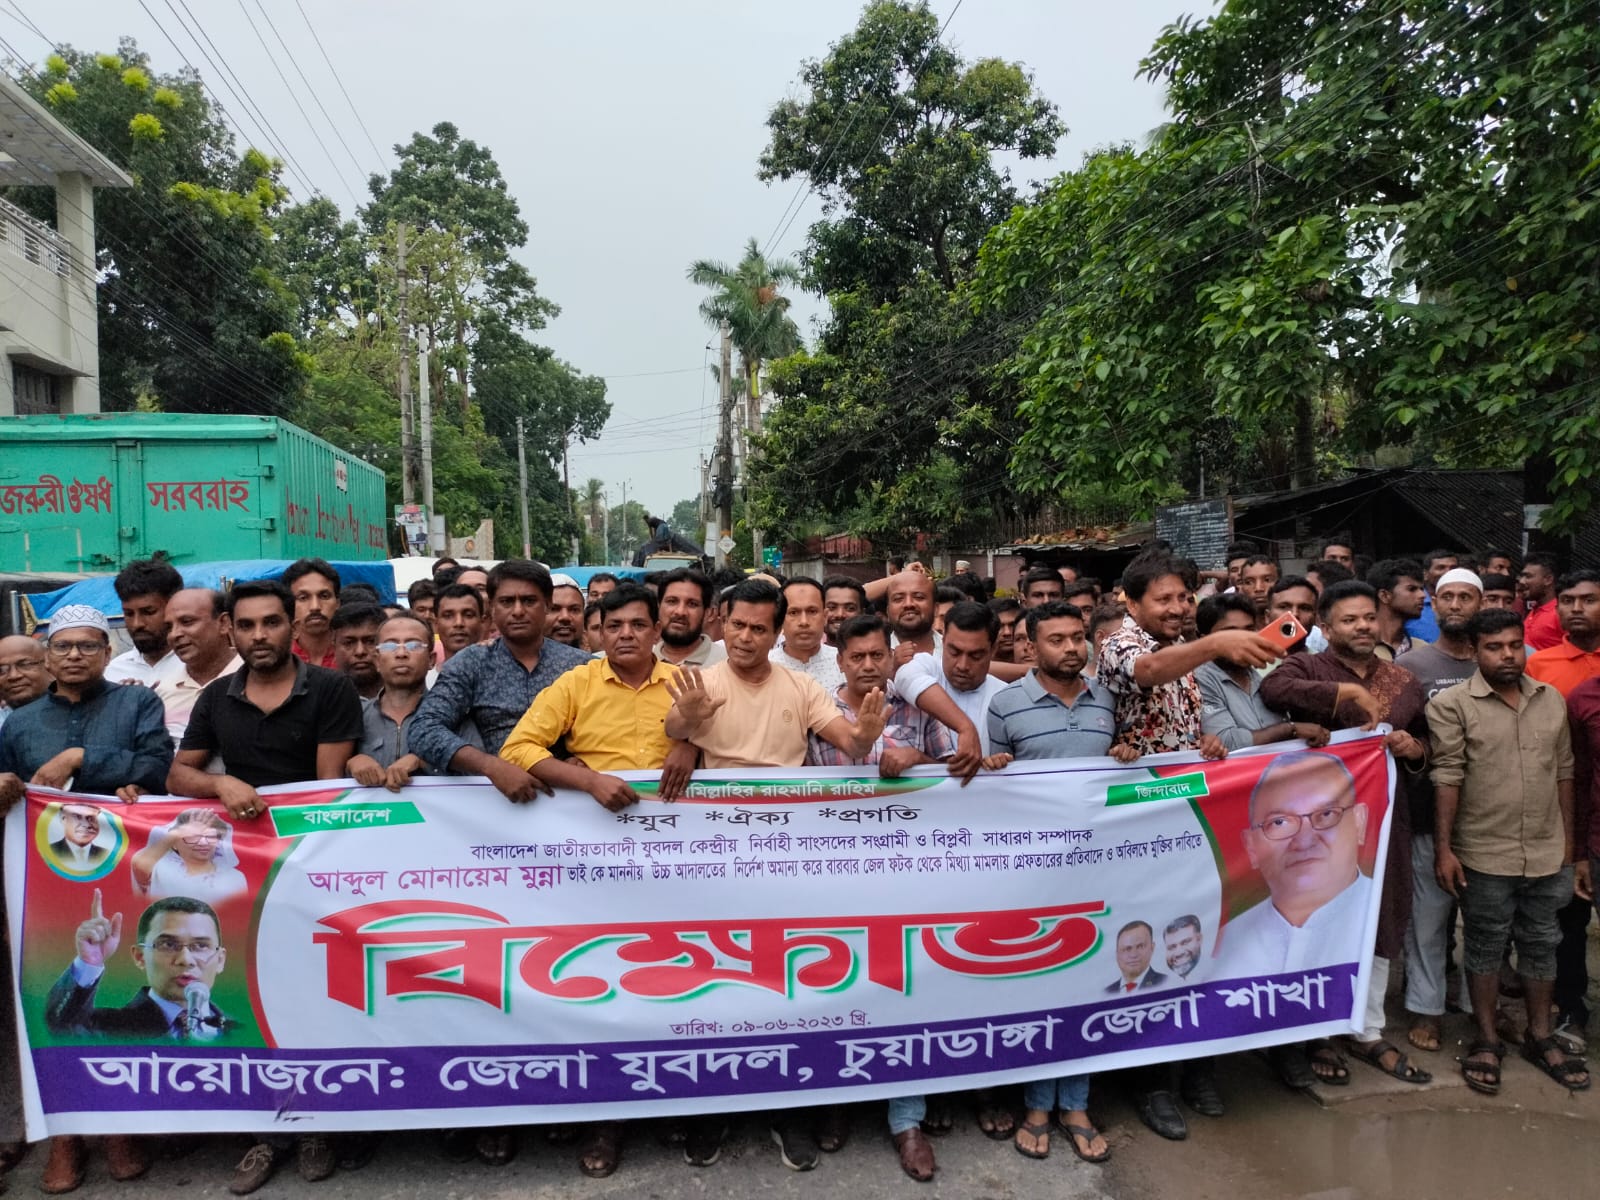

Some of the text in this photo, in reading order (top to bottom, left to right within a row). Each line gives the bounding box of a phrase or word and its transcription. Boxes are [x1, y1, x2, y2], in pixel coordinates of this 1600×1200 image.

[0, 474, 64, 515] জরুরী
[147, 477, 249, 512] সরবরাহ
[685, 781, 876, 798] মিল্লাহির রাহমানি রাহিম
[1135, 783, 1191, 800] জিন্দাবাদ
[302, 808, 392, 825] বাংলাদেশ
[471, 828, 1095, 860] বাংলাদেশ জাতীয়তাবাদী যুবদল কেন্দ্রীয় নির্বাহী সাংসদের সংগ্রামী ও বিপ্লবী সাধারণ সম্পাদক
[307, 870, 389, 896] আব্দুল
[397, 866, 511, 889] মোনায়েম
[517, 863, 564, 890] মুন্না
[567, 863, 588, 884] ভাই
[590, 865, 605, 883] কে
[608, 860, 644, 881] মাননীয়
[650, 859, 672, 881] উচ্চ
[674, 862, 727, 880] আদালতের
[733, 855, 765, 878] নির্দেশ
[767, 859, 799, 877] অমান্য
[802, 858, 823, 876] করে
[826, 857, 860, 875] বারবার
[863, 857, 886, 874] জেল
[888, 852, 914, 873] ফটক
[917, 855, 943, 873] থেকে
[946, 850, 971, 873] মিথ্যা
[974, 854, 1010, 872] মামলায়
[1013, 851, 1063, 871] গ্রেফতারের
[1065, 846, 1104, 866] প্রতিবাদে
[1106, 848, 1114, 861] ও
[1175, 830, 1204, 849] দাবিতে
[313, 899, 1111, 1015] বিক্ষোভ
[439, 1050, 596, 1092] জেলা
[612, 1042, 813, 1094] যুবদল,
[836, 1017, 1064, 1081] চুয়াডাঙ্গা
[1081, 989, 1207, 1043] জেলা
[1215, 972, 1333, 1018] শাখা
[731, 1014, 845, 1033] ০৯-০৬-২০২৩
